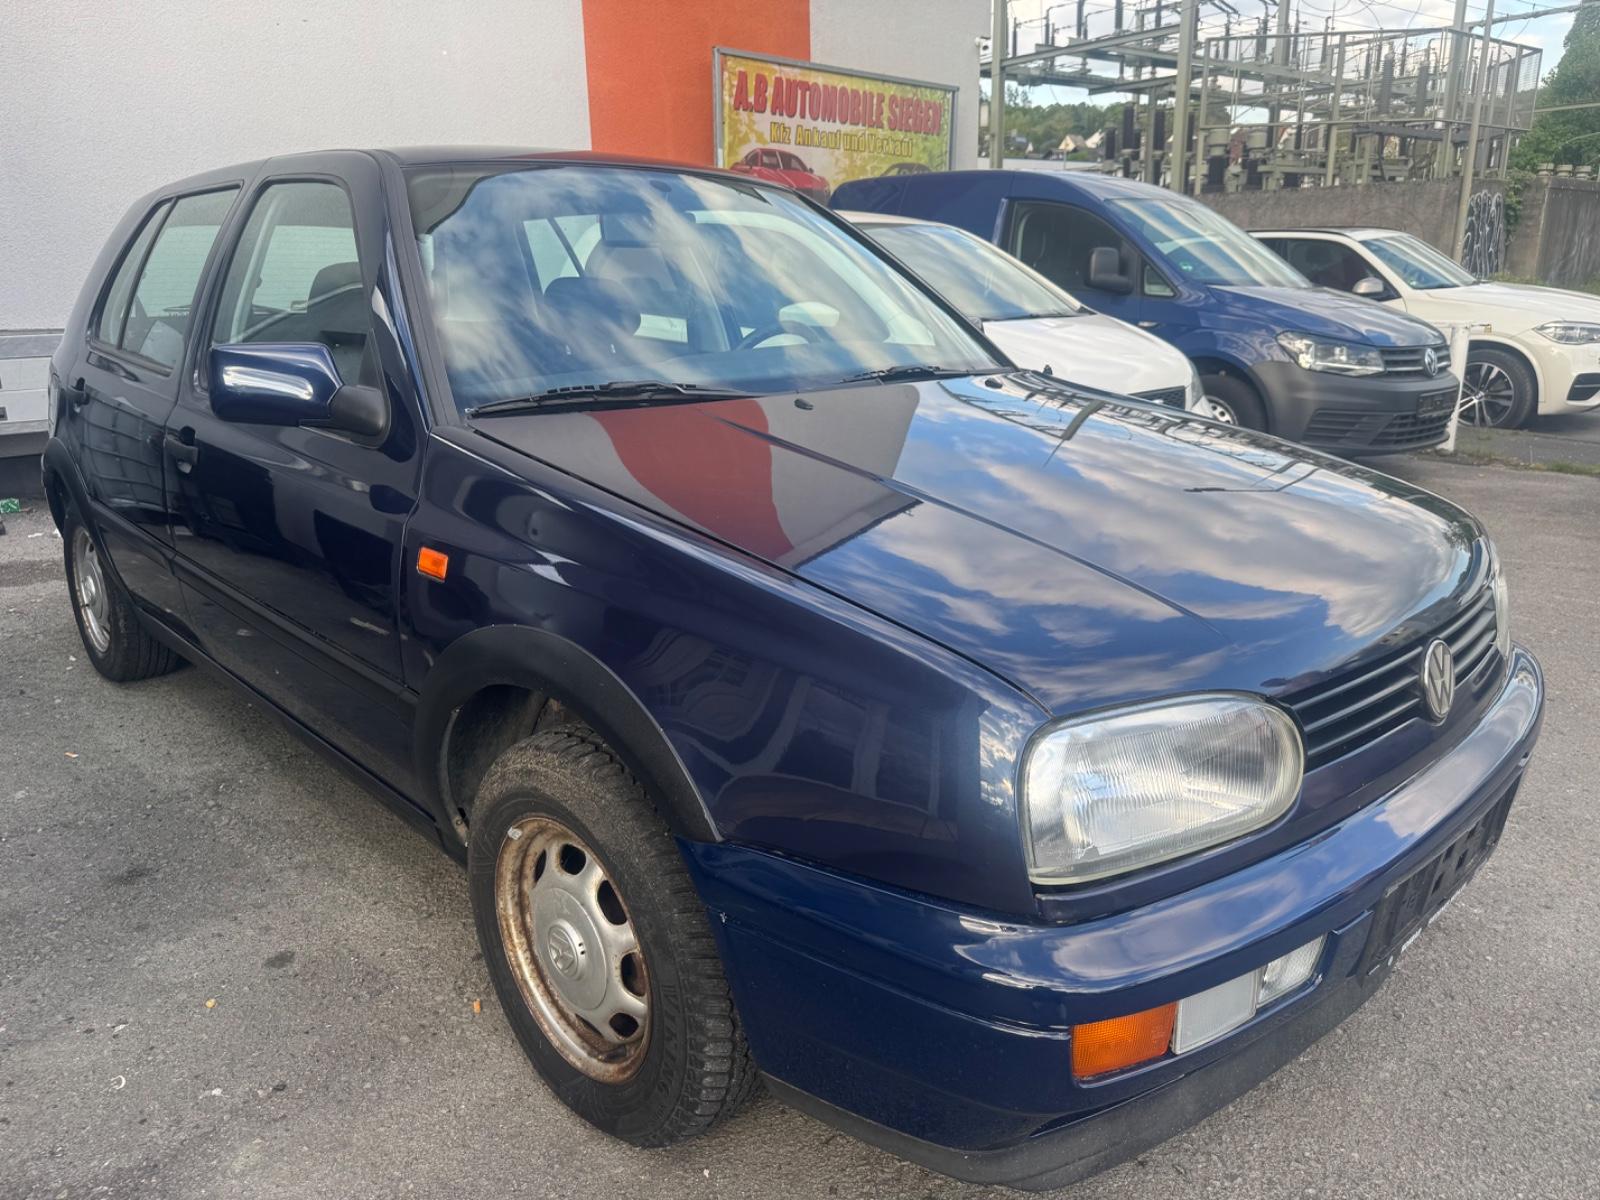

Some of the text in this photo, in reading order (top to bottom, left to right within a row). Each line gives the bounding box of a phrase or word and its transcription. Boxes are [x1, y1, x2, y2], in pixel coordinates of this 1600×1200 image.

[734, 70, 942, 136] A.B AUTOMOBILE SIEGEN
[771, 121, 792, 144] Kfz
[843, 132, 866, 153] und
[867, 132, 913, 158] Verkauf
[1424, 640, 1454, 717] VW
